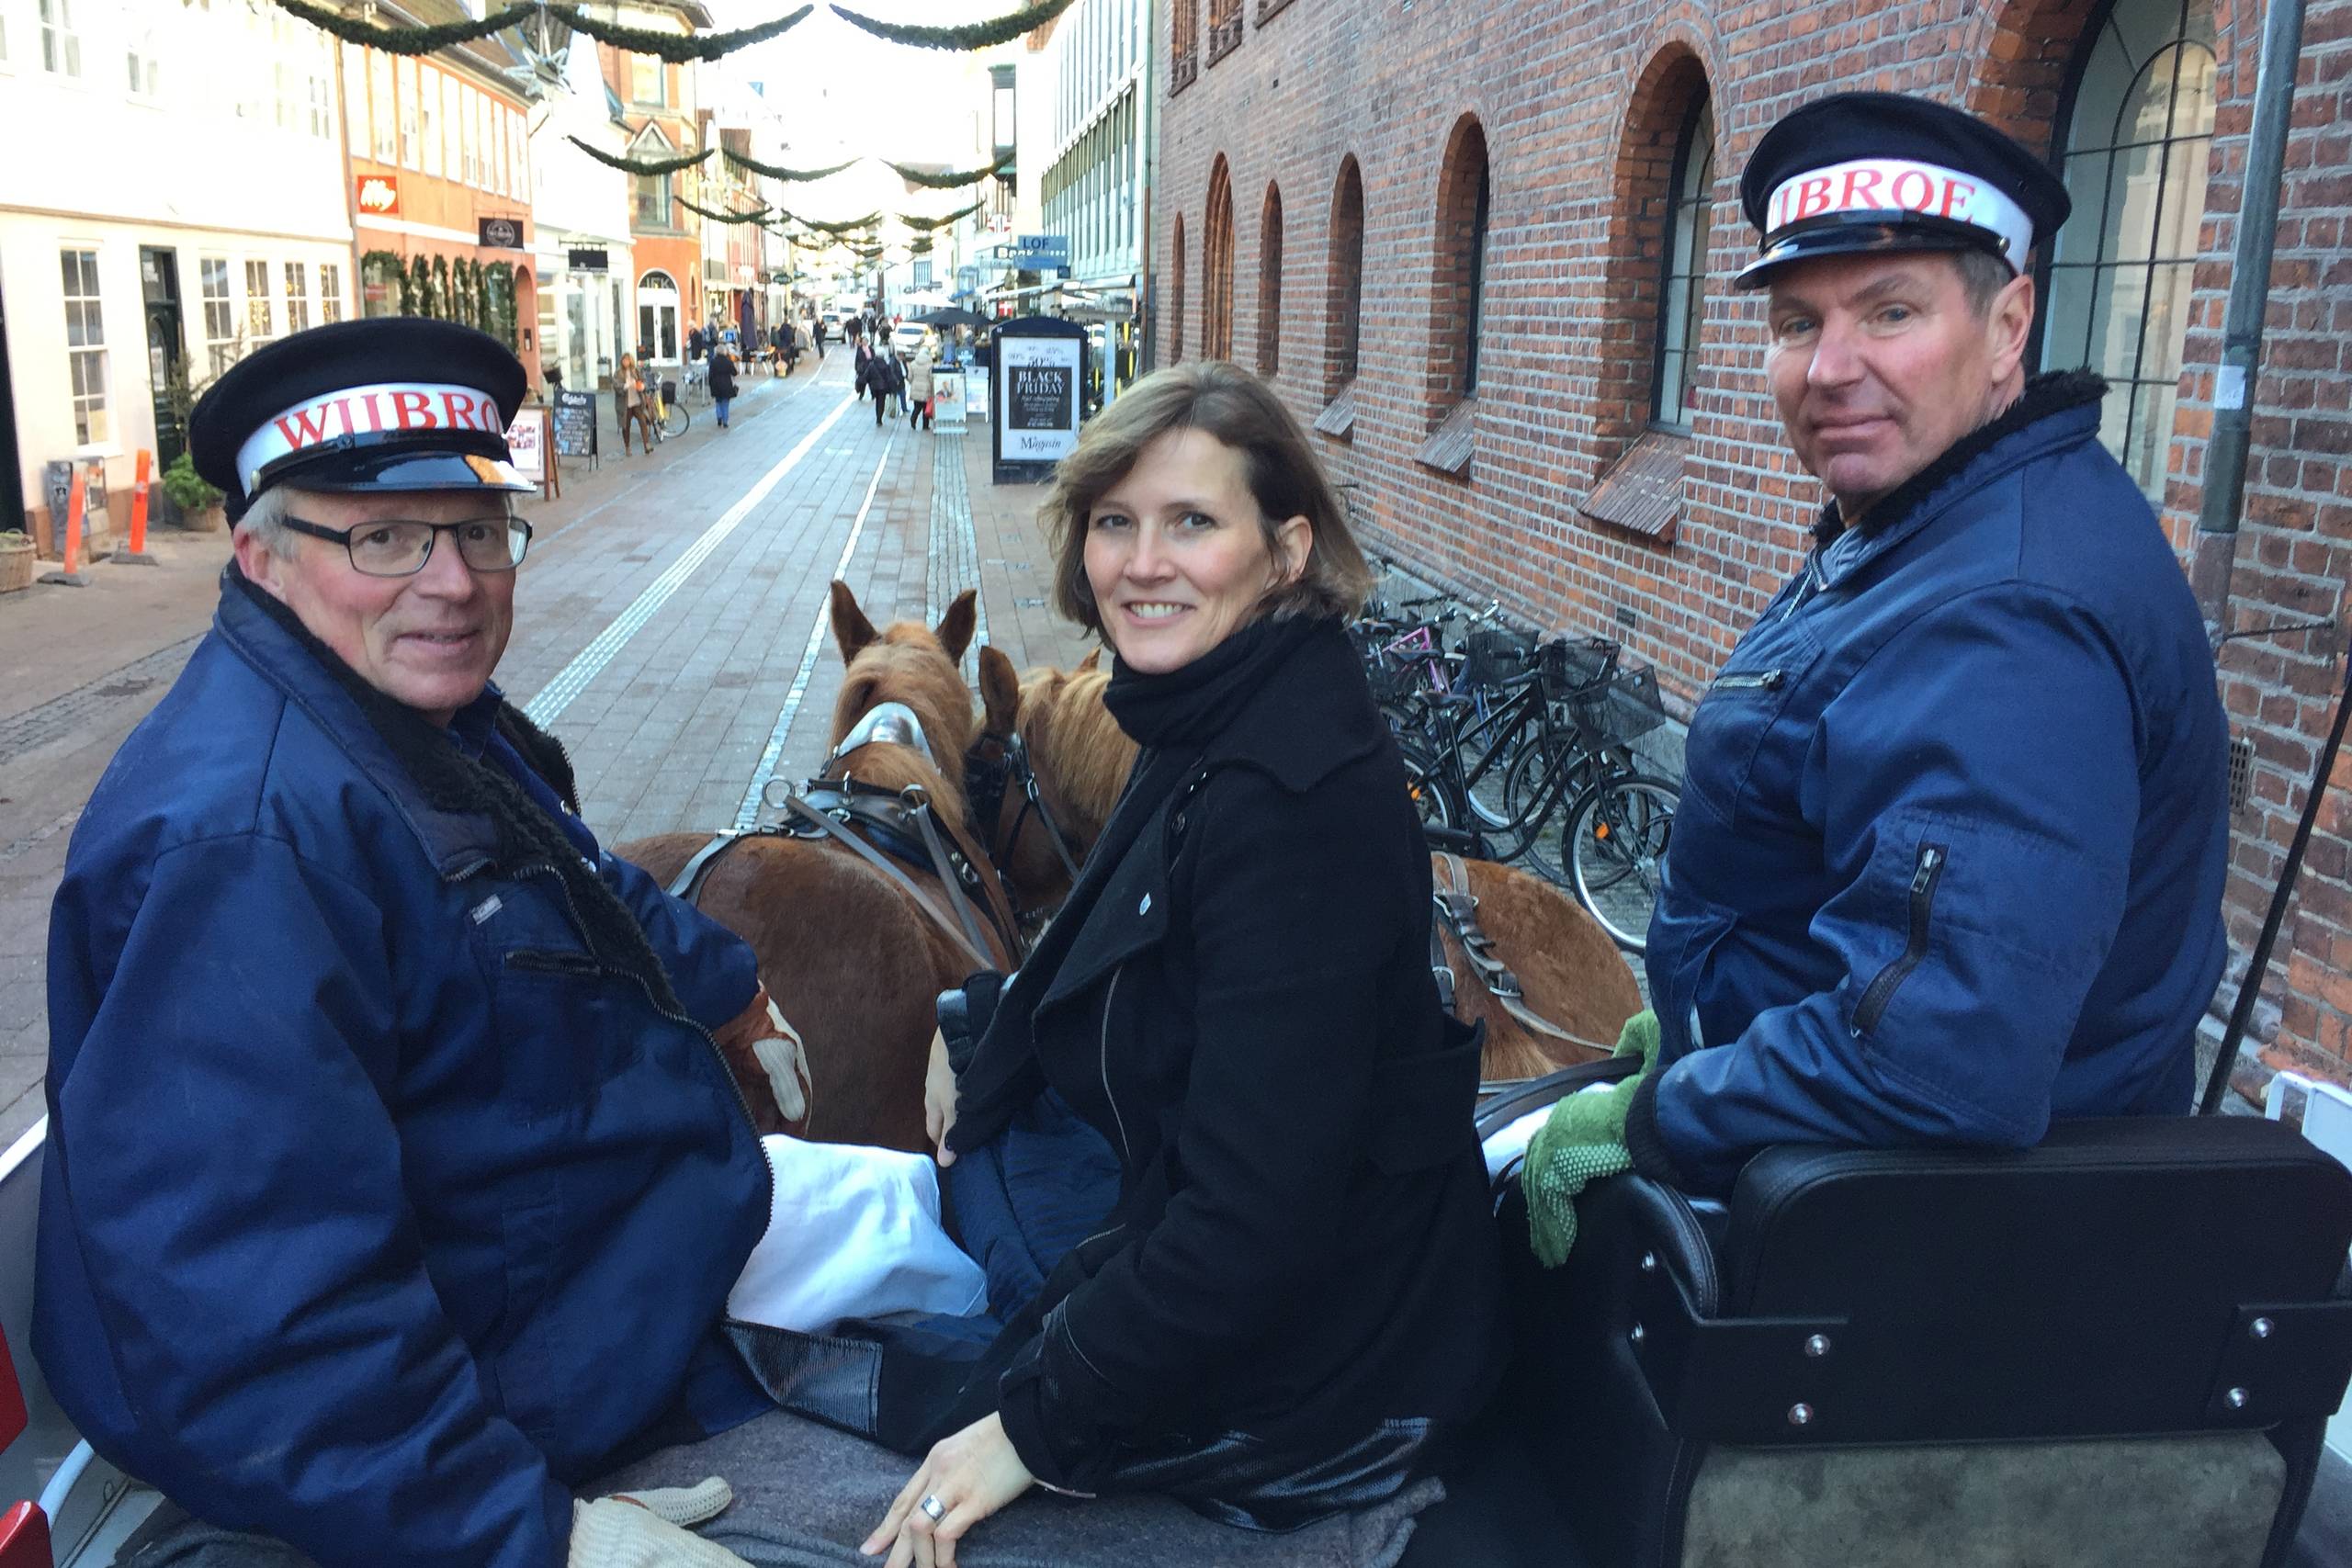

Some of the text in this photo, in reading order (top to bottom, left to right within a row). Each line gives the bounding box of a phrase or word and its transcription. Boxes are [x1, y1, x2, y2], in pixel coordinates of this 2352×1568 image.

[360, 178, 397, 212] illy
[1023, 237, 1049, 250] LOF
[1018, 370, 1063, 383] BLACK
[1016, 381, 1065, 395] FRIDAY
[1021, 436, 1062, 452] Magasin
